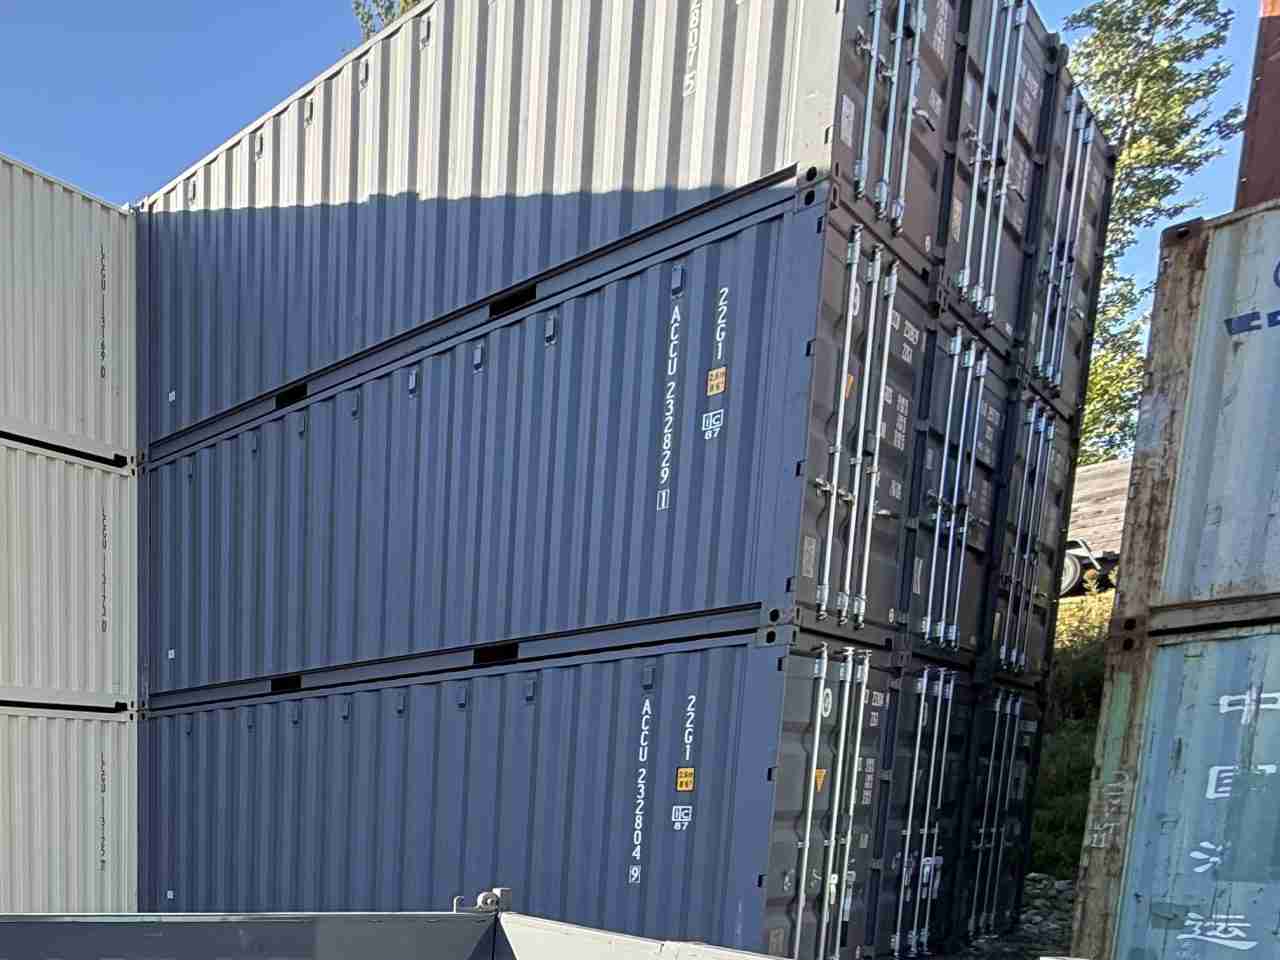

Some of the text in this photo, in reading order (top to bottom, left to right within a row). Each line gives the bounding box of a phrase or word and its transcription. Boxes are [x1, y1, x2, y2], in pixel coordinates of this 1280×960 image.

[668, 305, 681, 376] ACCU
[716, 288, 729, 360] 22G1
[660, 382, 676, 485] 232829
[638, 698, 652, 762] ACCU
[684, 695, 697, 761] 22G1
[632, 768, 647, 860] 232804
[673, 821, 689, 831] 87
